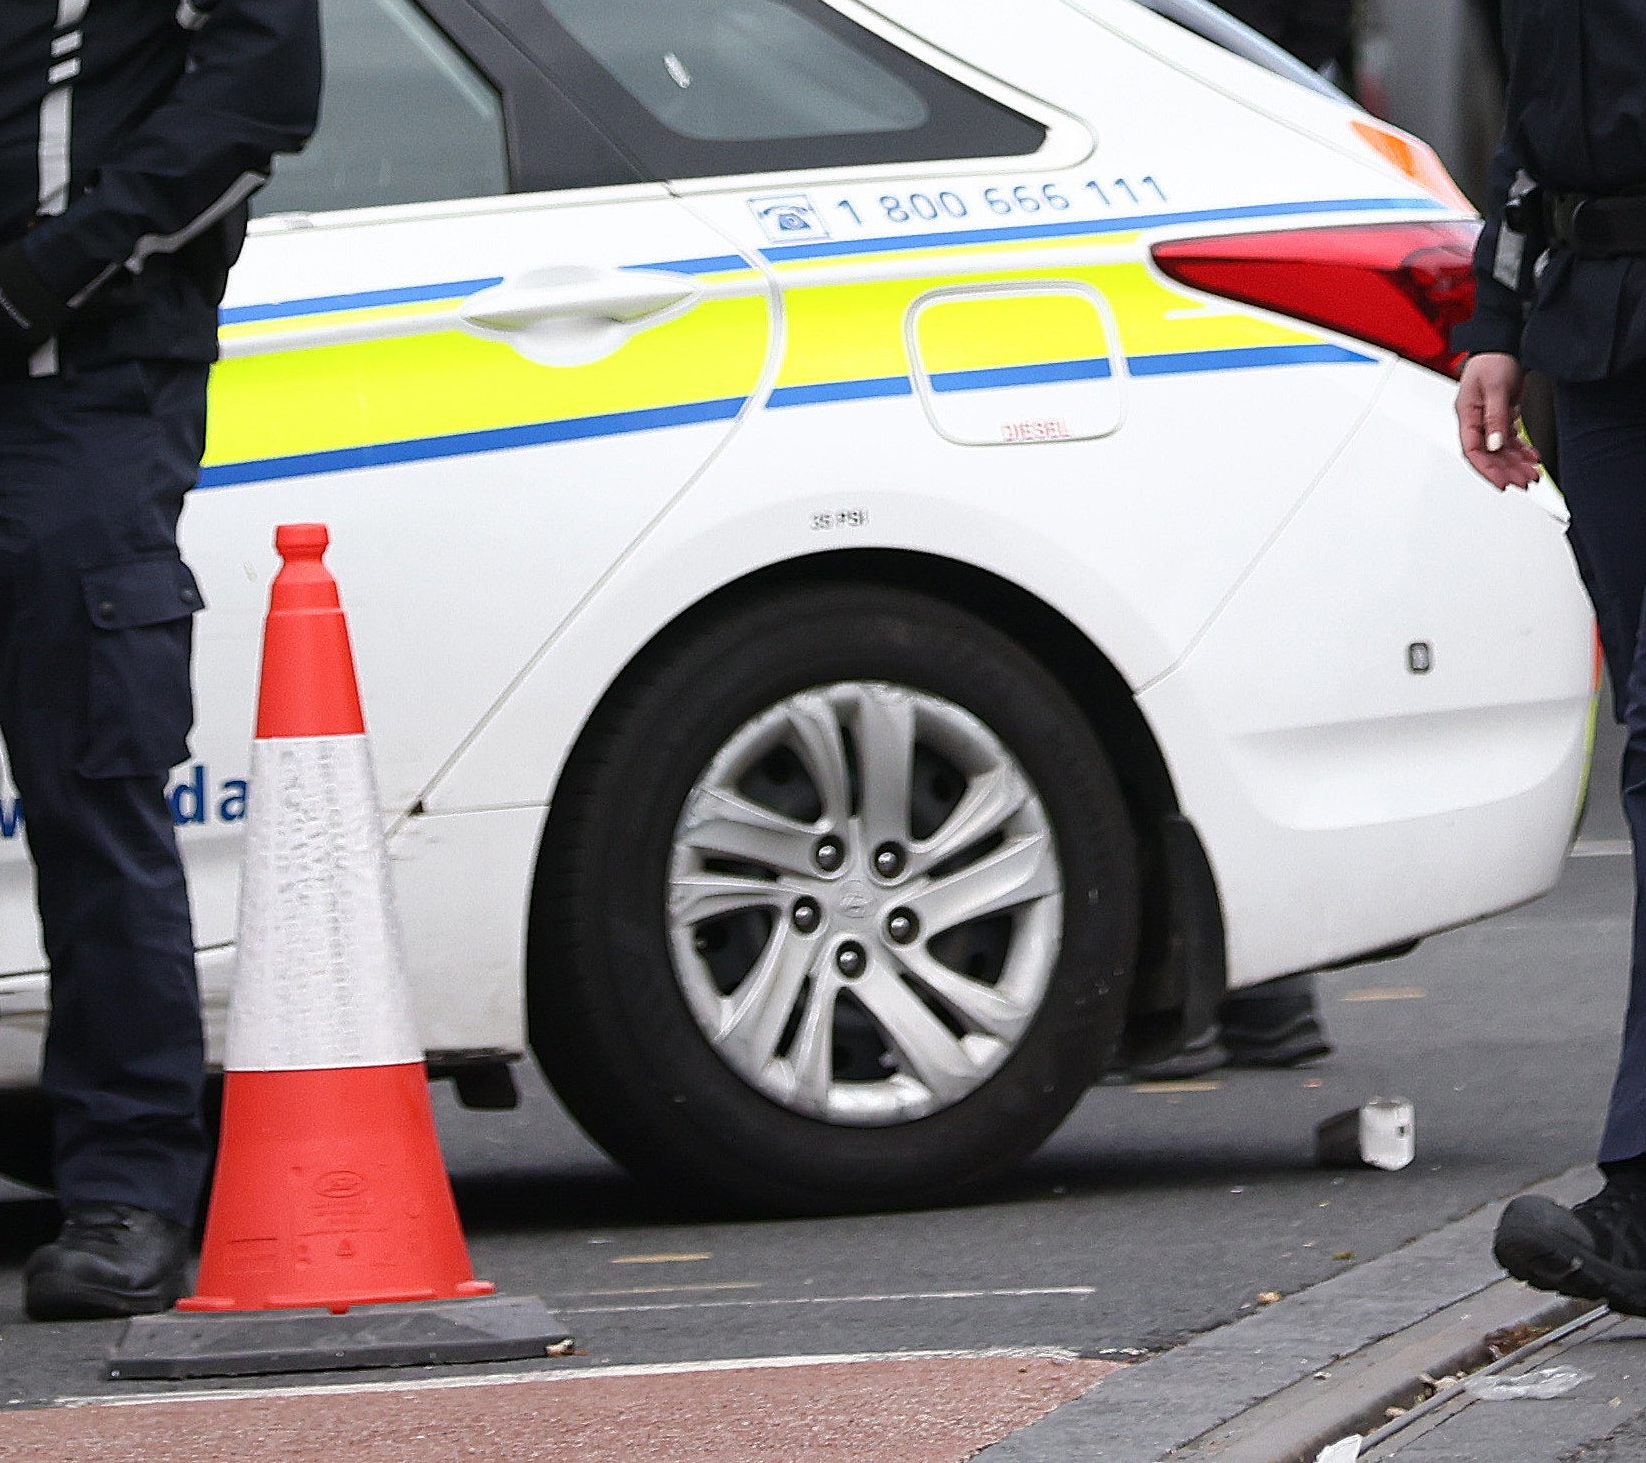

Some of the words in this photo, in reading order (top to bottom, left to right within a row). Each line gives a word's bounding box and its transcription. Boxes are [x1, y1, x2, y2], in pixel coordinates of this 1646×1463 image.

[836, 198, 863, 226] 1
[879, 191, 968, 223] 800
[984, 183, 1070, 215] 666
[1086, 175, 1169, 208] 111
[1003, 419, 1070, 442] DIESEL
